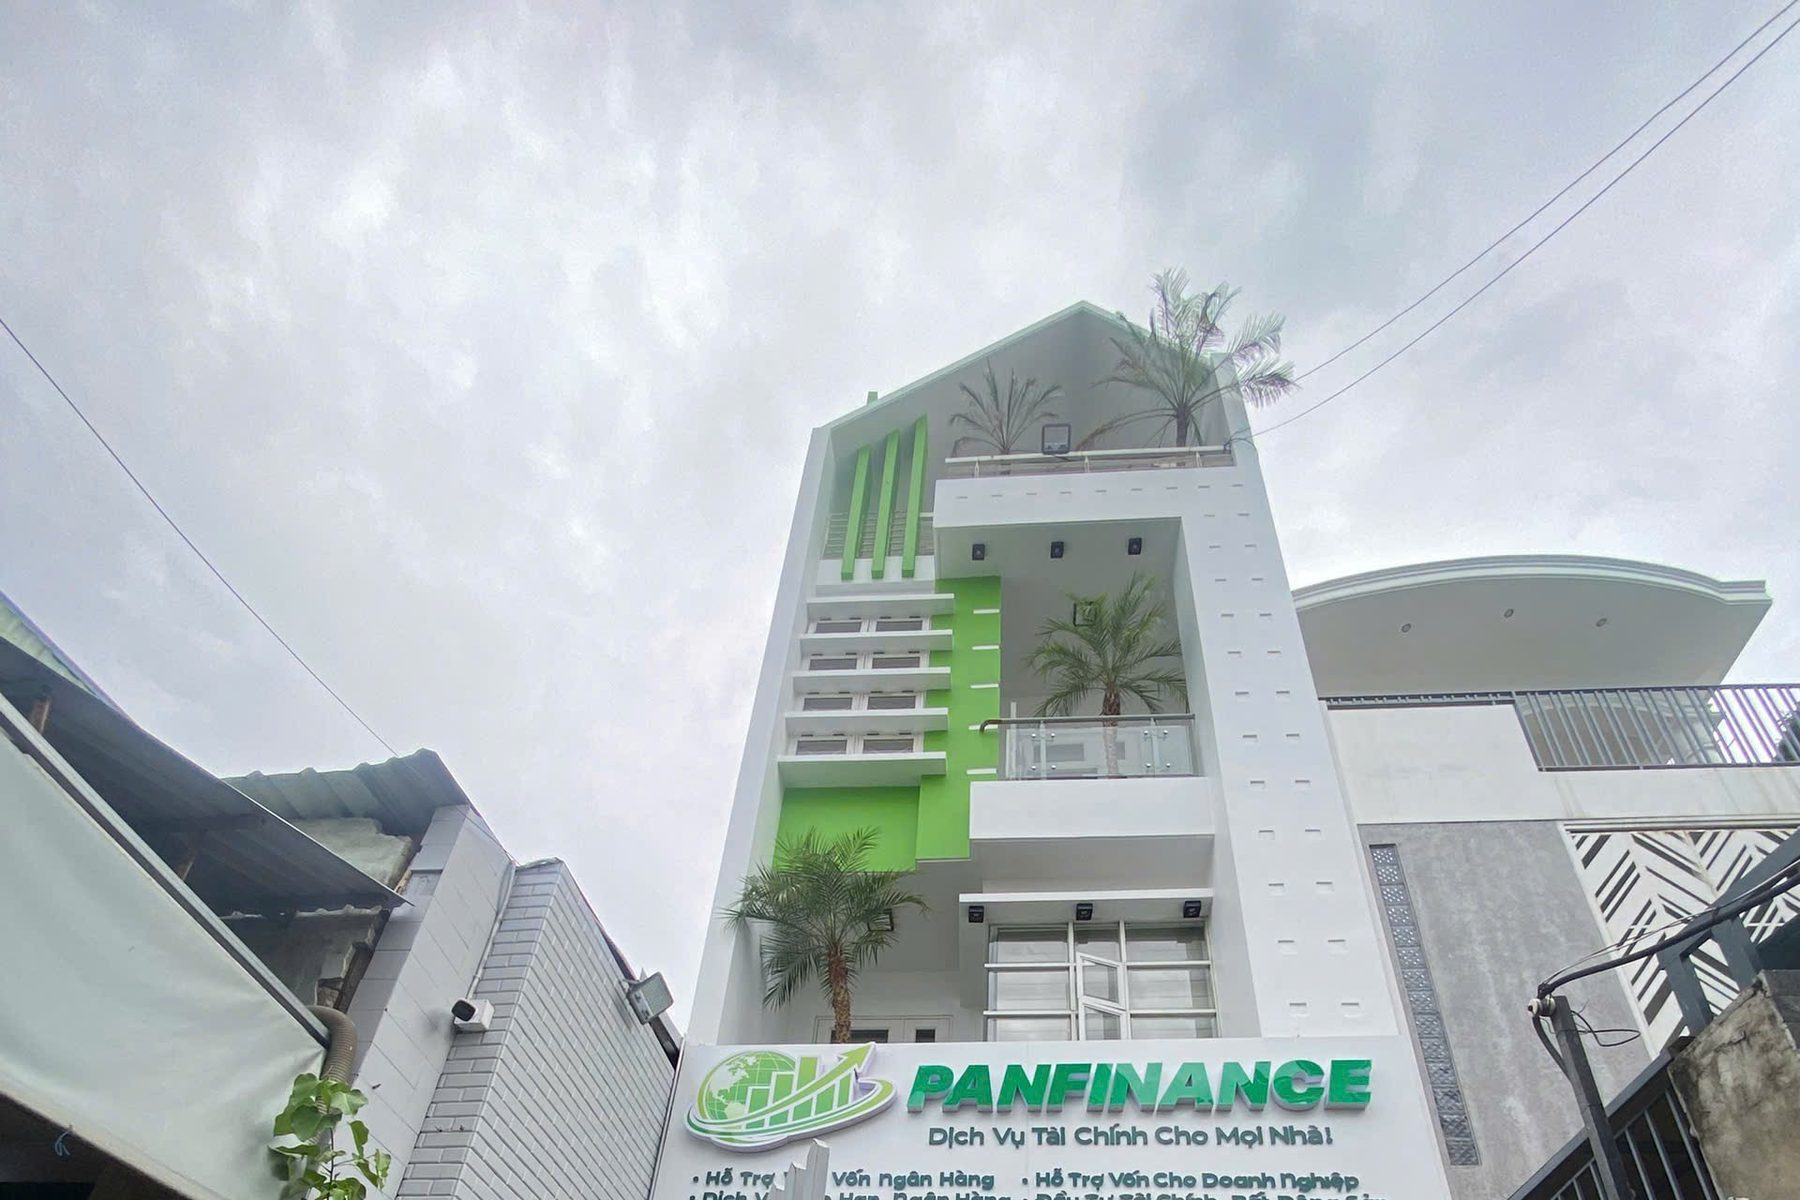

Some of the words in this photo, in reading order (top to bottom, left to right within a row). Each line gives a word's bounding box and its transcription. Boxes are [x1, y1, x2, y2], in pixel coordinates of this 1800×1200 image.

[906, 1059, 1372, 1113] PANFINANCE
[928, 1126, 985, 1149] Dịch
[992, 1127, 1026, 1150] Vụ
[1032, 1126, 1066, 1146] Tài
[1074, 1123, 1148, 1146] Chính
[1155, 1125, 1209, 1146] Cho
[1215, 1126, 1264, 1149] Mọi
[1269, 1125, 1334, 1146] Nhà!
[705, 1167, 734, 1187] Hỗ
[831, 1169, 871, 1187] Vốn
[939, 1170, 994, 1191] Hàng
[1035, 1168, 1064, 1188] Hỗ
[1068, 1172, 1104, 1191] Trợ
[1108, 1170, 1150, 1188] Vốn
[1153, 1172, 1197, 1188] Cho
[1201, 1172, 1276, 1189] Doanh
